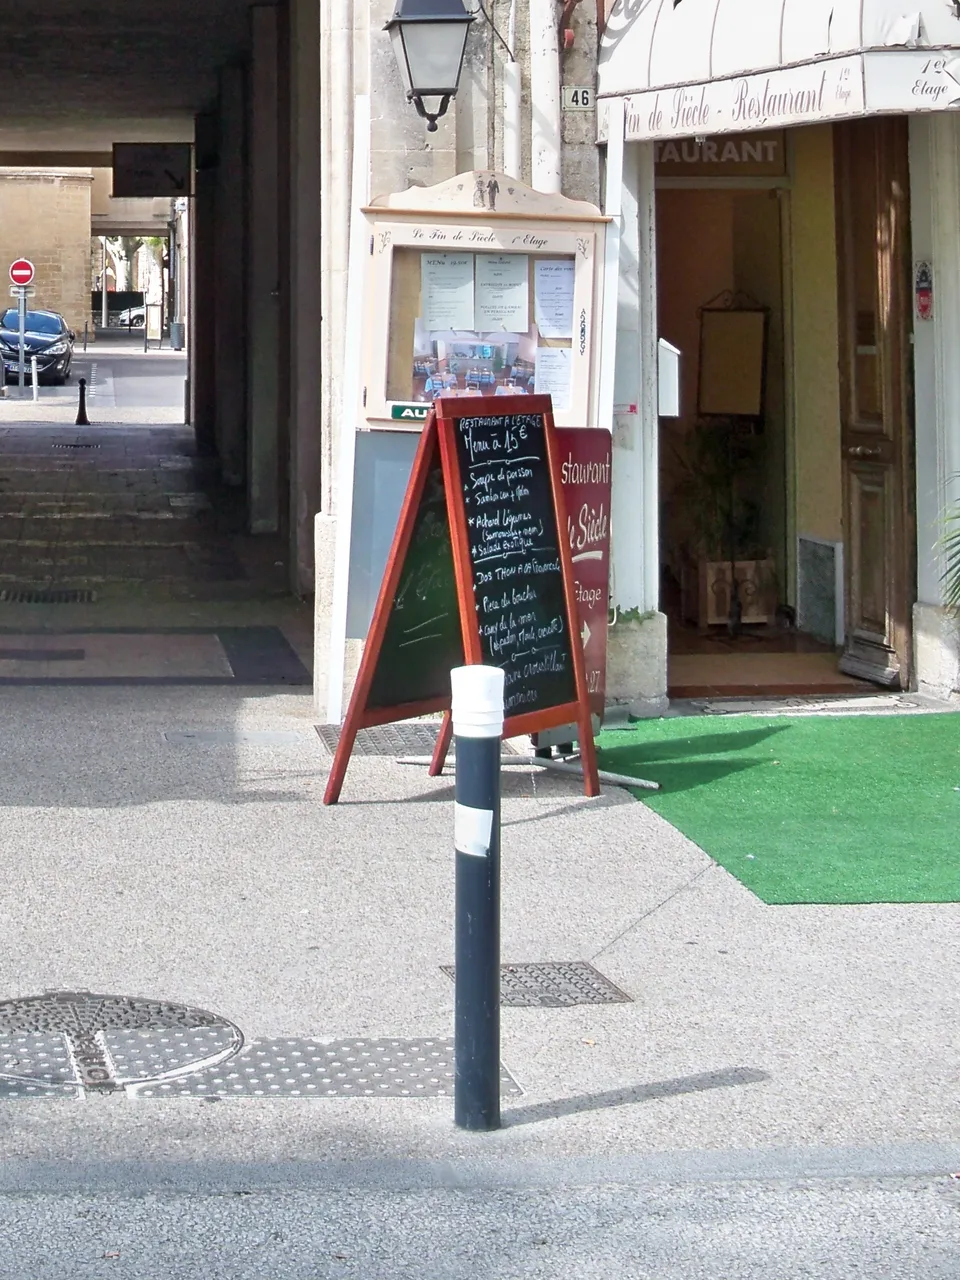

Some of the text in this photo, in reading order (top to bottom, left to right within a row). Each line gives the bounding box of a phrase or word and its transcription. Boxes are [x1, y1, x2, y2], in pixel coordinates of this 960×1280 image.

[571, 89, 589, 106] 46
[732, 70, 827, 122] Restaurant
[653, 140, 778, 163] TAURANT
[429, 228, 446, 240] Fin
[452, 231, 463, 241] de
[401, 408, 428, 418] AU
[464, 427, 490, 462] Menu
[561, 452, 610, 484] staurant
